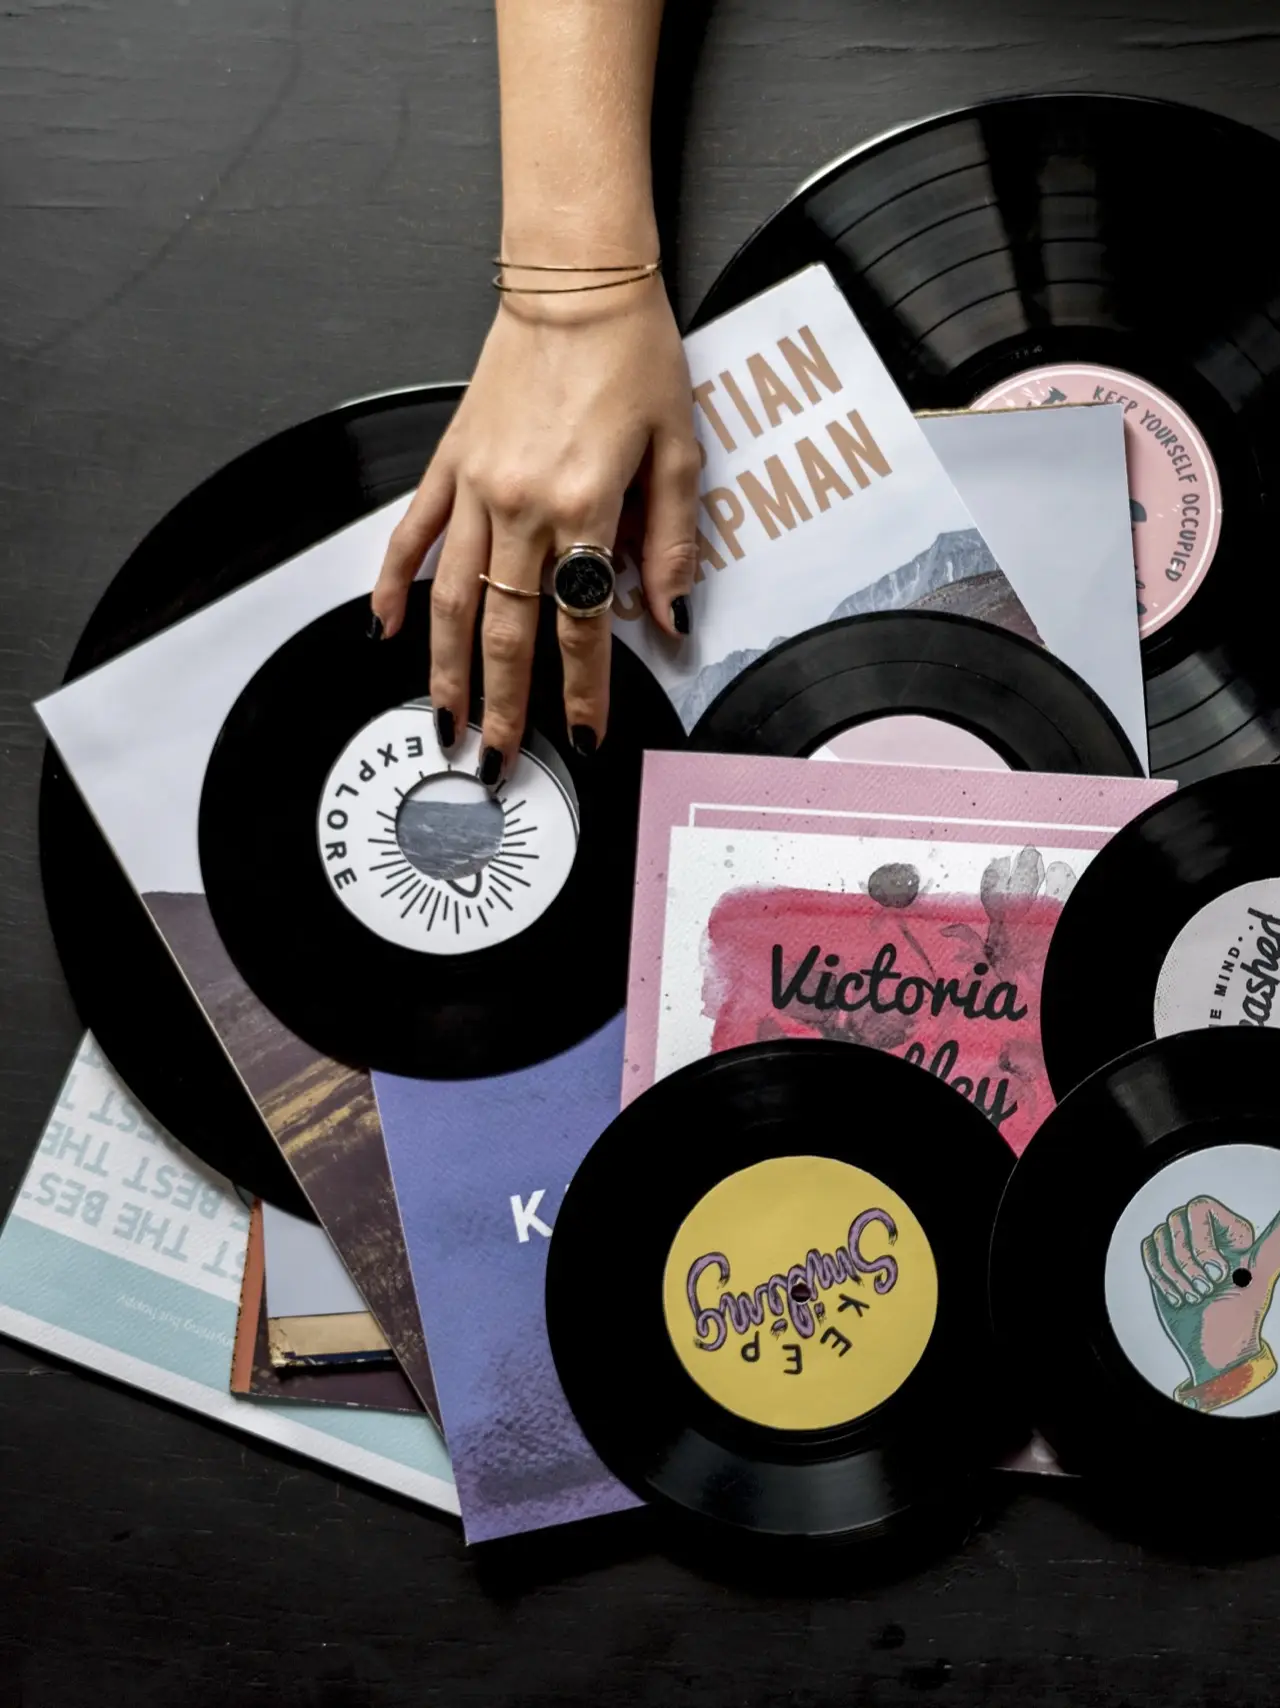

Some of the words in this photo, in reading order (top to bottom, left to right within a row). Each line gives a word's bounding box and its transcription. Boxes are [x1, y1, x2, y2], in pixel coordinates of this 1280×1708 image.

[1139, 408, 1198, 484] YOURSELF
[1164, 493, 1200, 582] OCCUPIED
[325, 735, 424, 890] EXPLORE
[770, 942, 1029, 1022] Victoria
[21, 1171, 110, 1229] BES
[121, 1155, 228, 1221] BEST
[112, 1201, 190, 1263] THE
[686, 1207, 899, 1352] Smiling
[740, 1292, 870, 1375] KEEP
